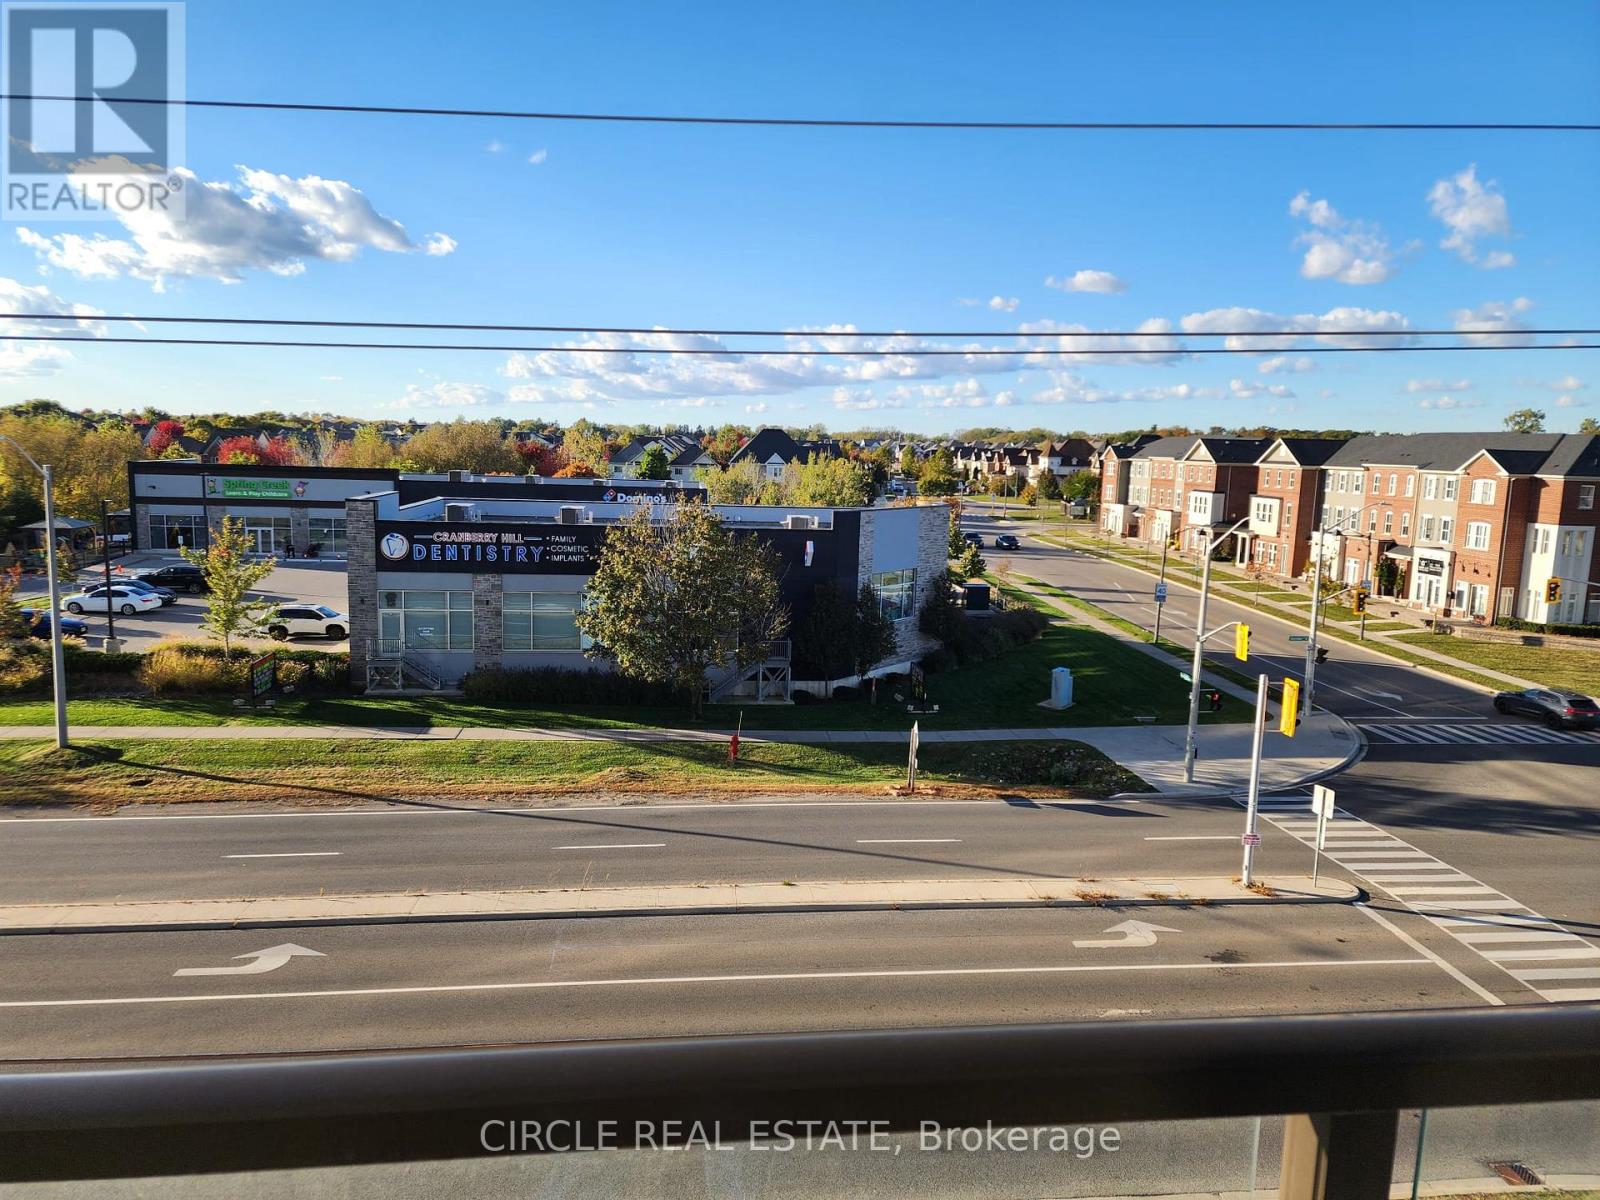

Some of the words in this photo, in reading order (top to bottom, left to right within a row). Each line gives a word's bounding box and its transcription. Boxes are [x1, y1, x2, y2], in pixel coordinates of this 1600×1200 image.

[223, 480, 257, 490] Spring
[261, 480, 289, 490] Creek
[617, 492, 667, 504] Domino's
[433, 531, 499, 543] CRANBERRY
[501, 533, 525, 543] HILL
[551, 535, 577, 543] FAMILY
[413, 544, 544, 563] DENTISTRY
[551, 544, 589, 553] COSMETIC
[551, 554, 585, 562] IMPLANTS
